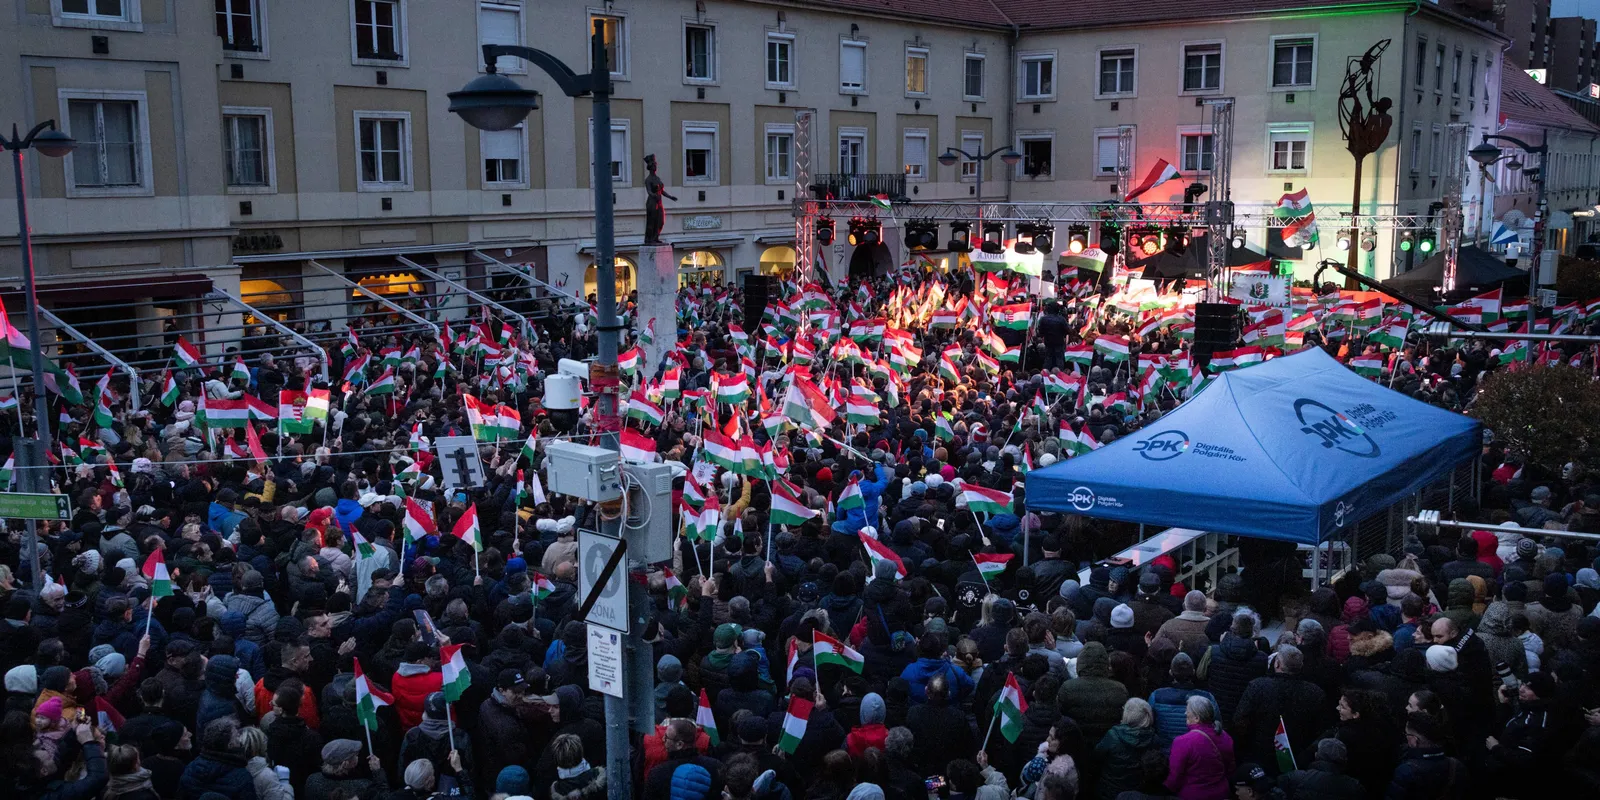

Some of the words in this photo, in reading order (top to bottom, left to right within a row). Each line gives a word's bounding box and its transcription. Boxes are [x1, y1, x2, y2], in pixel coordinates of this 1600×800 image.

[1300, 415, 1360, 449] DPK
[1132, 440, 1183, 452] DPK
[1195, 442, 1234, 454] Digitális
[1192, 448, 1227, 459] Polgári
[1229, 454, 1247, 463] Kör
[1067, 493, 1091, 504] DPK
